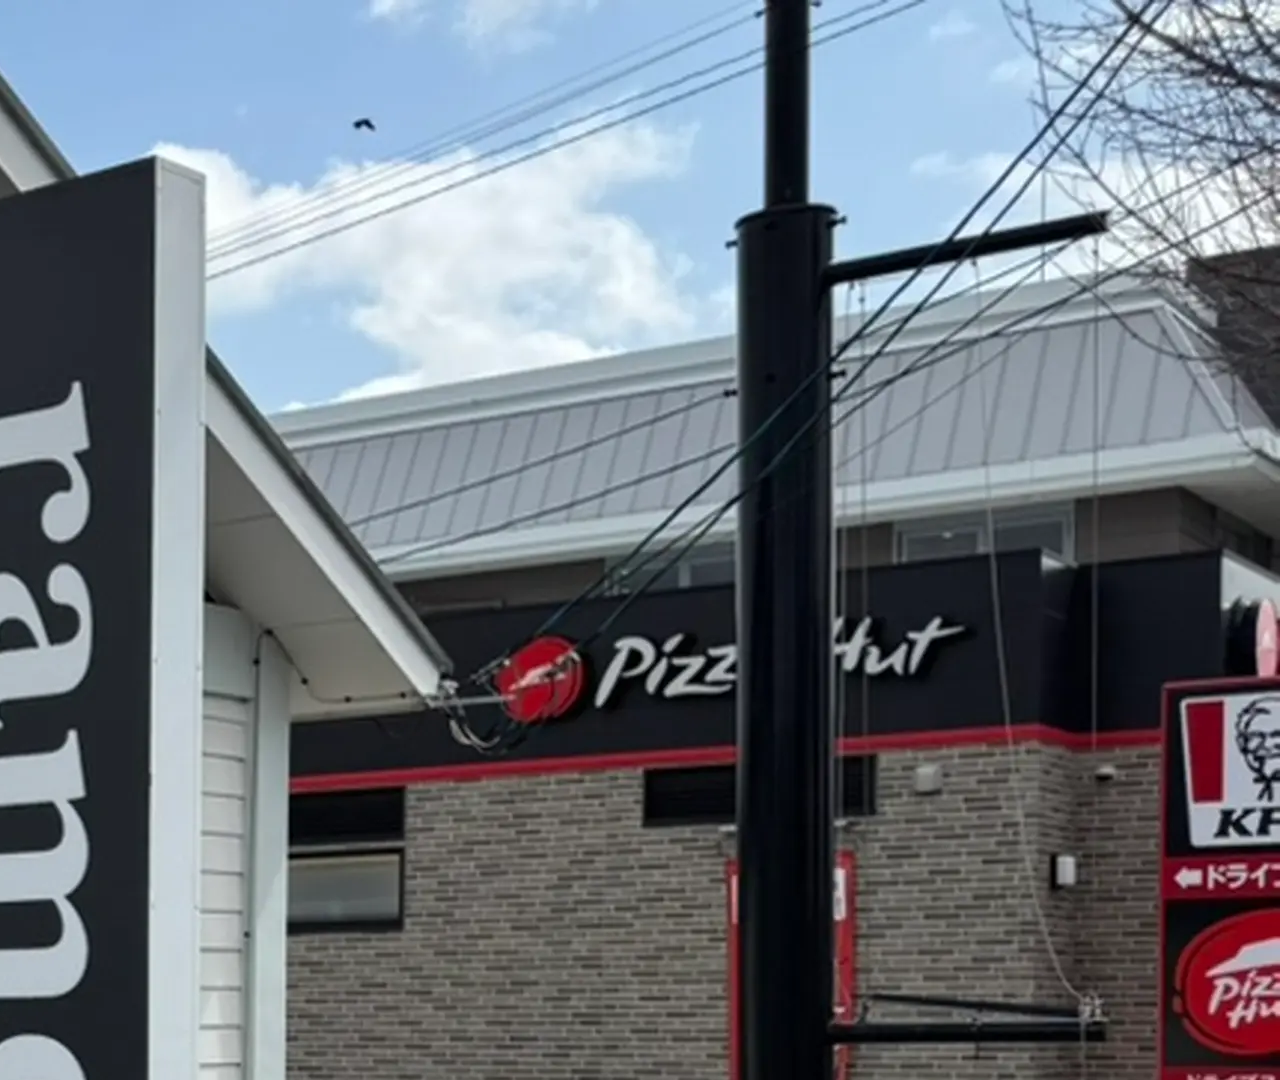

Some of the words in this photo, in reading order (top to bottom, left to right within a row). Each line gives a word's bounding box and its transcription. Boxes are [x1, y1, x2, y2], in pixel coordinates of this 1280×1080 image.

[595, 634, 738, 708] Pizz
[832, 616, 965, 675] Hut
[1213, 807, 1280, 838] KF
[1208, 968, 1280, 1015] Piz
[1226, 999, 1280, 1030] Hu
